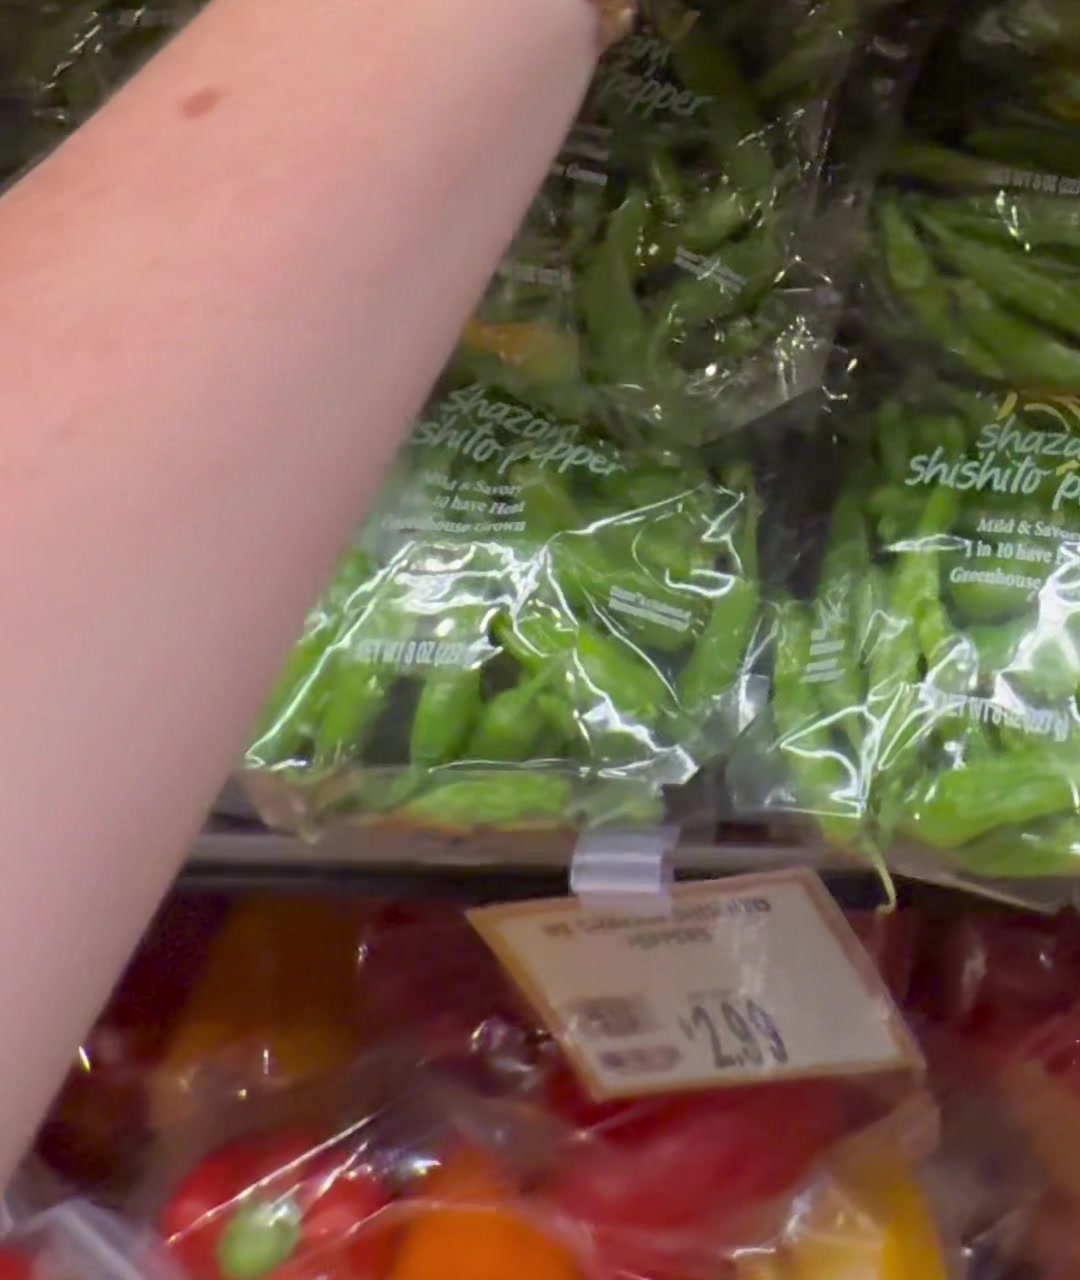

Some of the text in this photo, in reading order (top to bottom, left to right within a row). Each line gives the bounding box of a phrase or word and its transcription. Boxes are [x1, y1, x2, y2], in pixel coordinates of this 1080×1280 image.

[976, 518, 1015, 534] Mild
[1016, 519, 1031, 536] &
[976, 540, 992, 558] in
[996, 541, 1014, 559] 10
[1015, 543, 1053, 564] have
[949, 565, 1042, 590] Greenhouse
